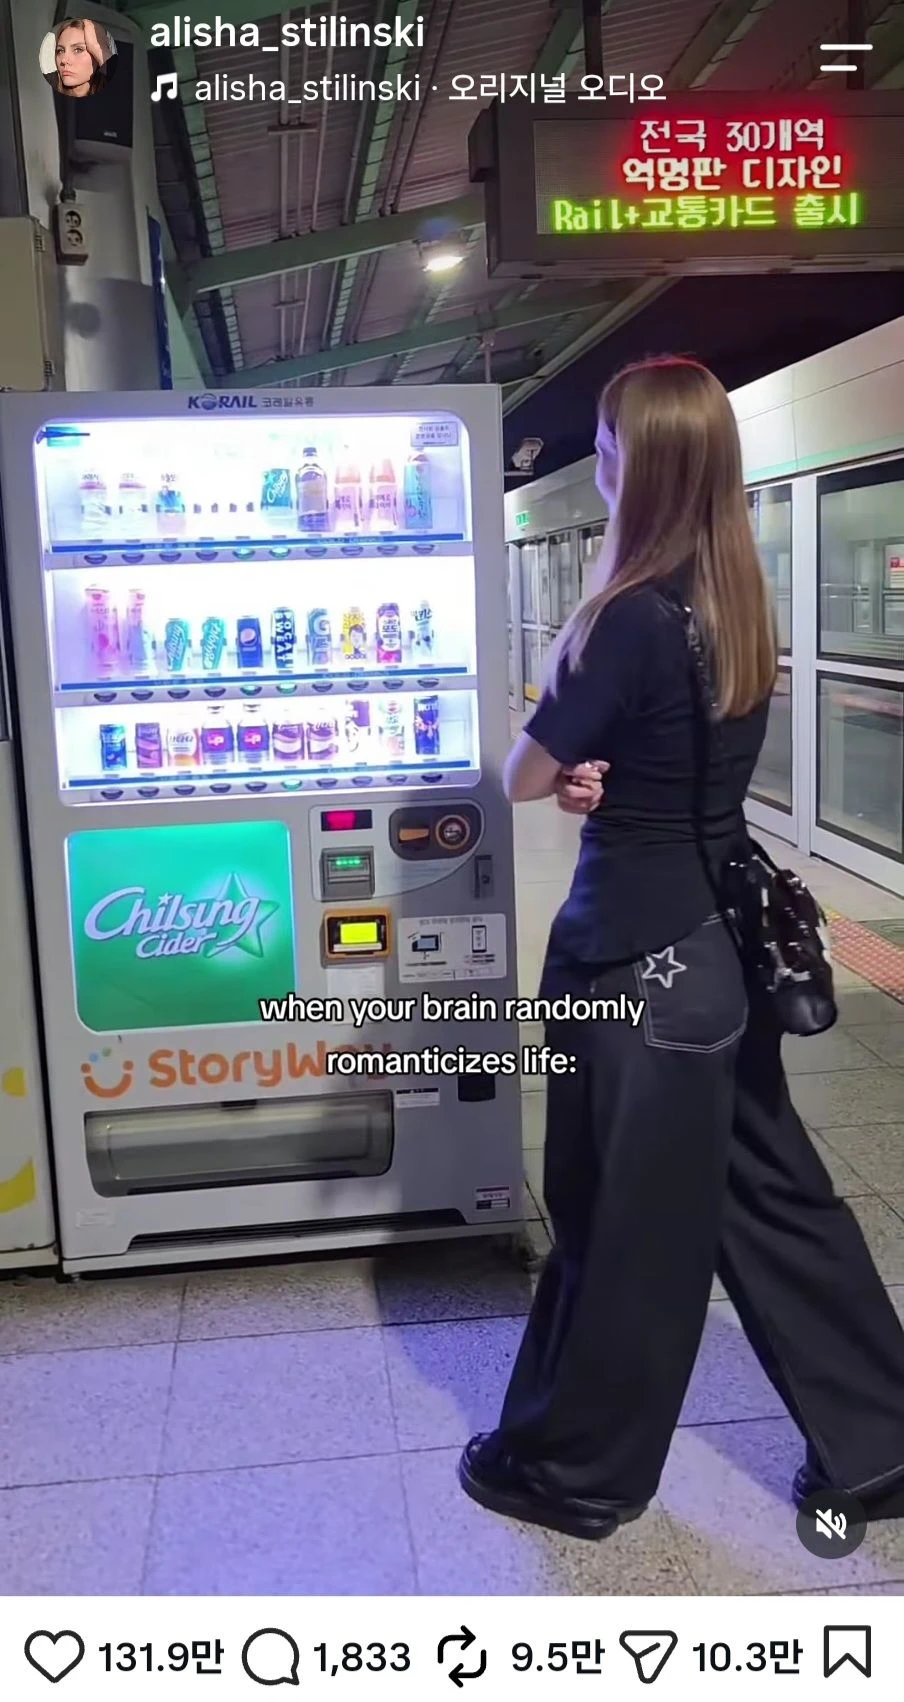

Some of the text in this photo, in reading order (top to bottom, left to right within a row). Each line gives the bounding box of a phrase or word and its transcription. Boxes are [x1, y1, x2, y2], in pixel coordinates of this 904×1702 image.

[640, 118, 826, 153] 전국 30개역
[622, 155, 842, 191] 역명판 디자인
[554, 192, 858, 231] Rail+교통카드 출시
[136, 930, 218, 959] Cider
